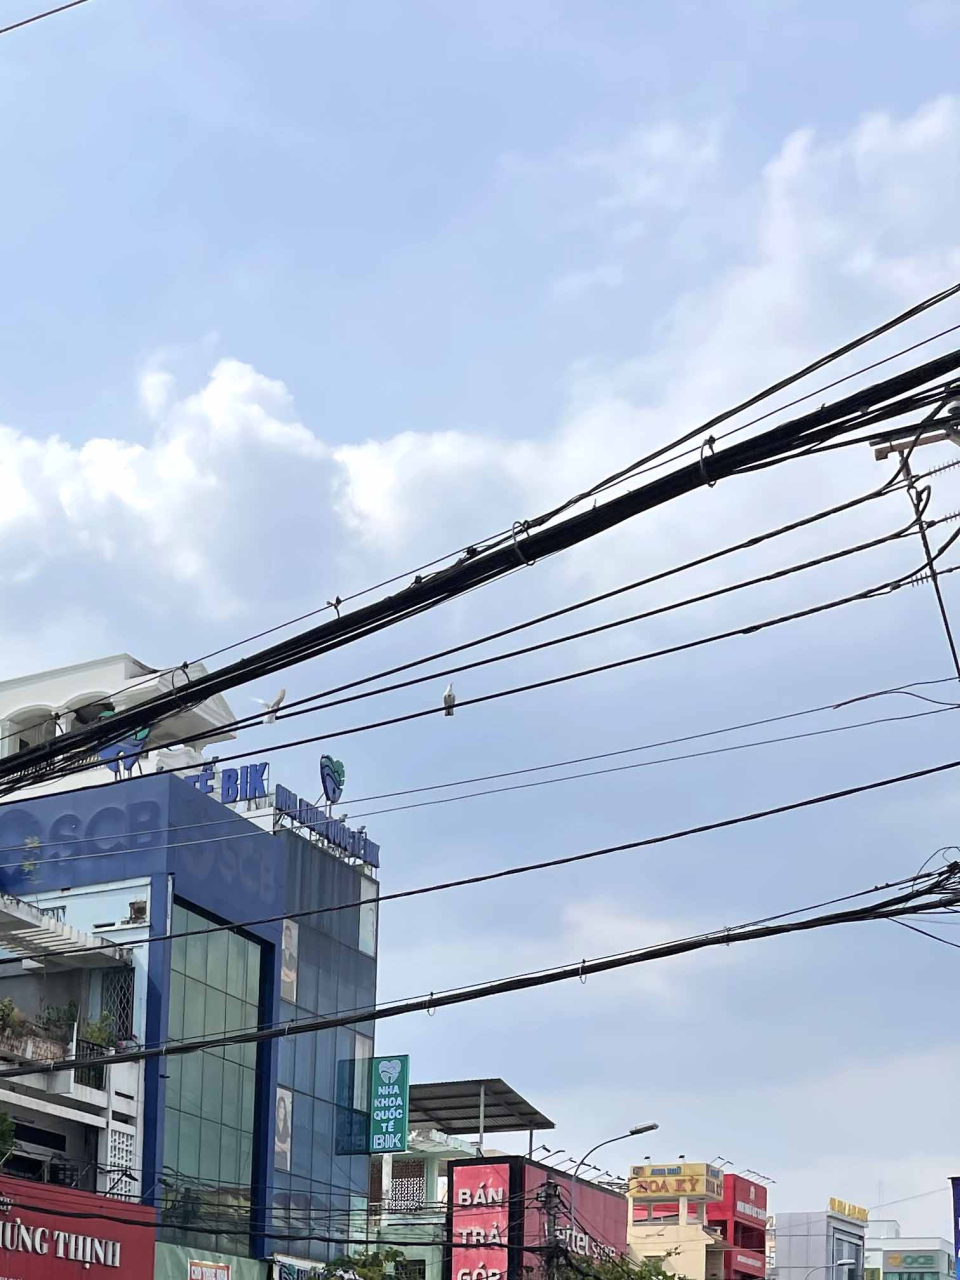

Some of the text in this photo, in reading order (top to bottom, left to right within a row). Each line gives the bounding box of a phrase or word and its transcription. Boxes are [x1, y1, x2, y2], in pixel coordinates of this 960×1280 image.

[221, 762, 268, 804] BIK
[378, 1085, 400, 1095] NHA
[374, 1096, 403, 1108] KHOA
[373, 1106, 403, 1120] QUỐC
[380, 1119, 395, 1132] TẾ
[373, 1133, 402, 1149] BIK
[458, 1182, 504, 1206] BÁN
[458, 1223, 502, 1245] TRẢ
[53, 1230, 121, 1269] THỊNH
